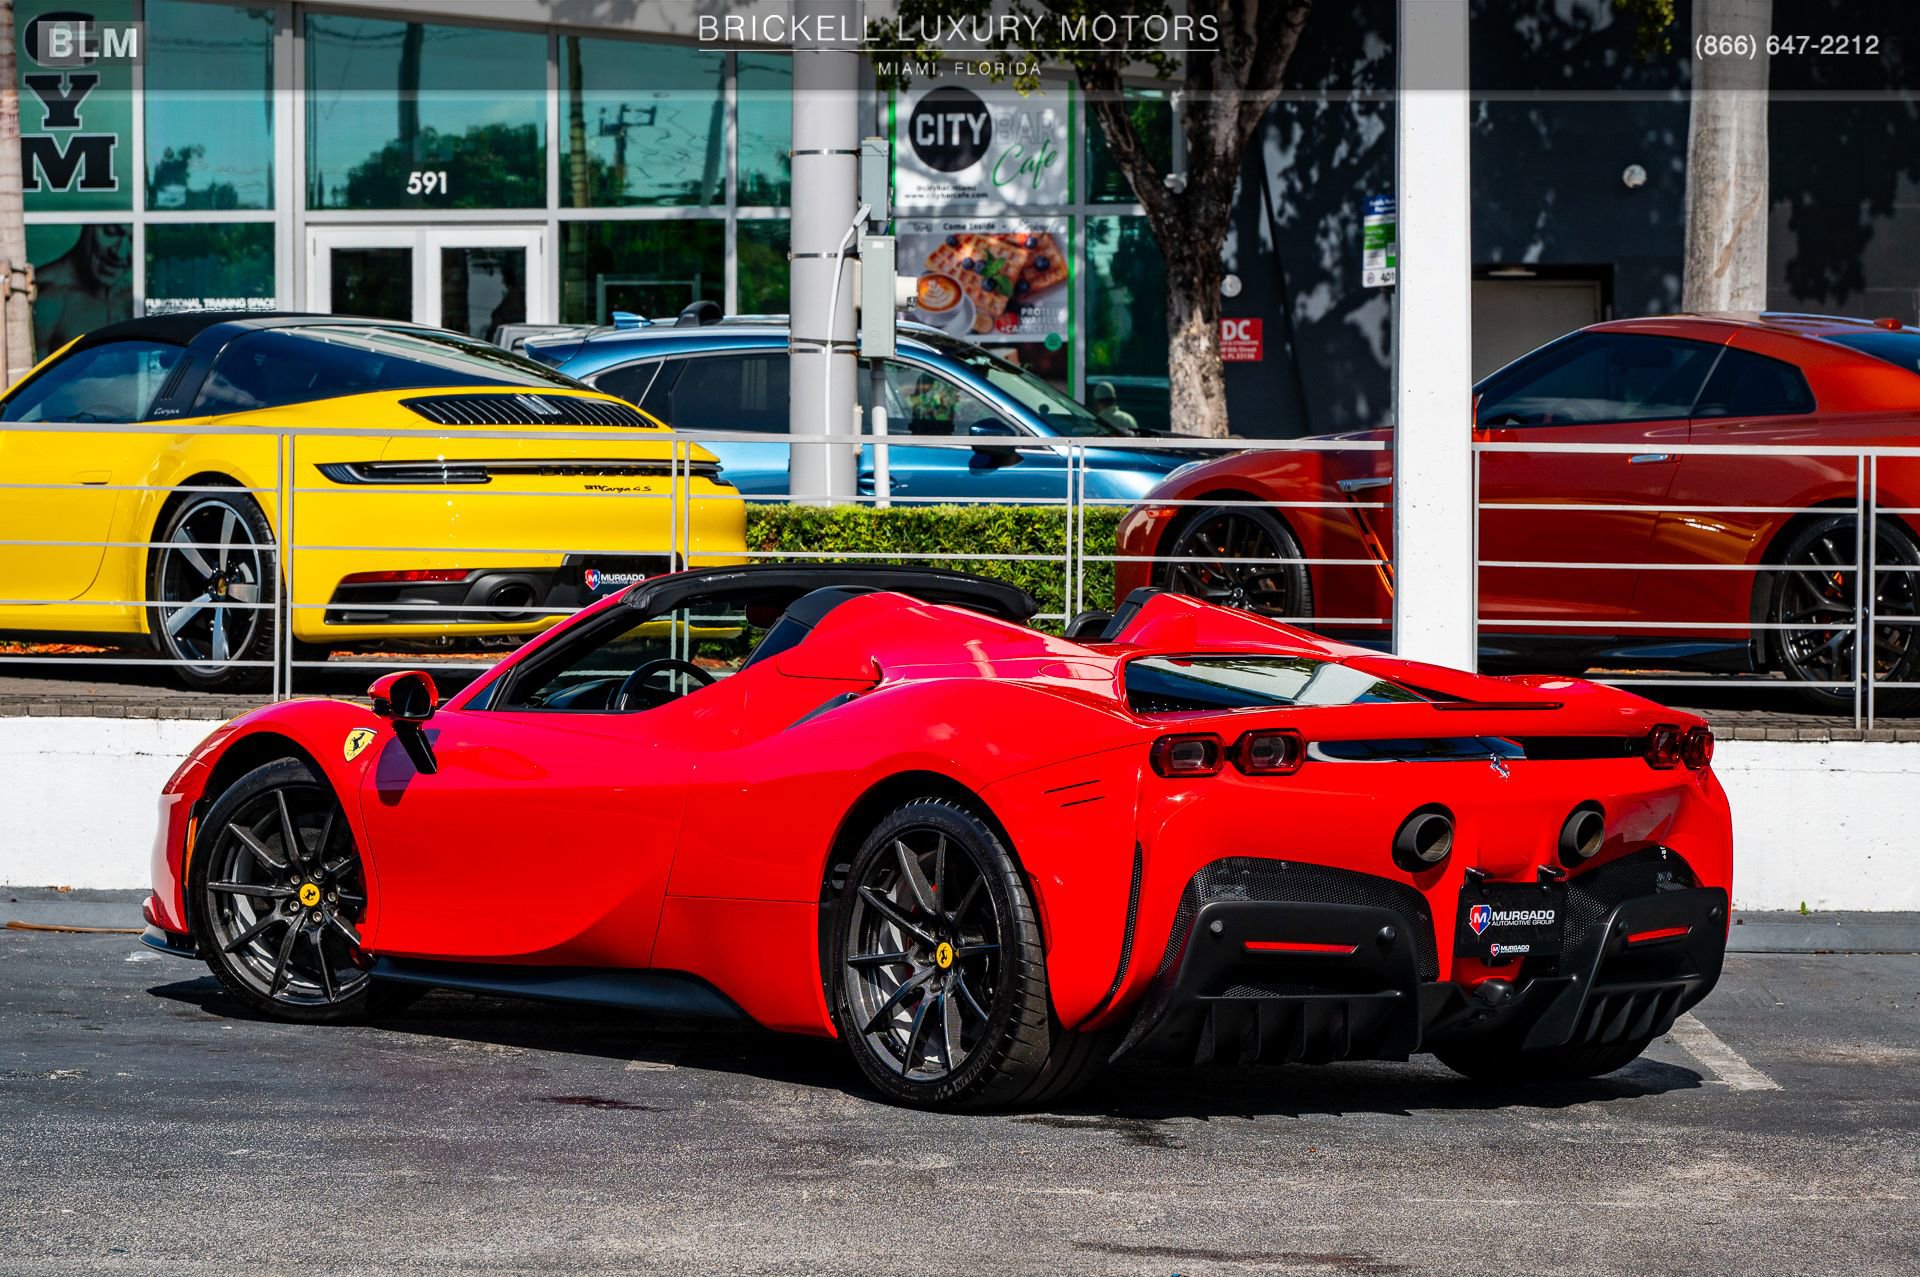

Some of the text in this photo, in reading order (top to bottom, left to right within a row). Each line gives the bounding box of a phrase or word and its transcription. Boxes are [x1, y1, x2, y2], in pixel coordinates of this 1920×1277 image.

[21, 11, 118, 192] GYM
[915, 112, 1057, 147] CITY BAR
[406, 171, 447, 195] 591
[943, 222, 966, 231] Come
[600, 573, 645, 581] MURGADO
[1491, 910, 1555, 921] MURGADO
